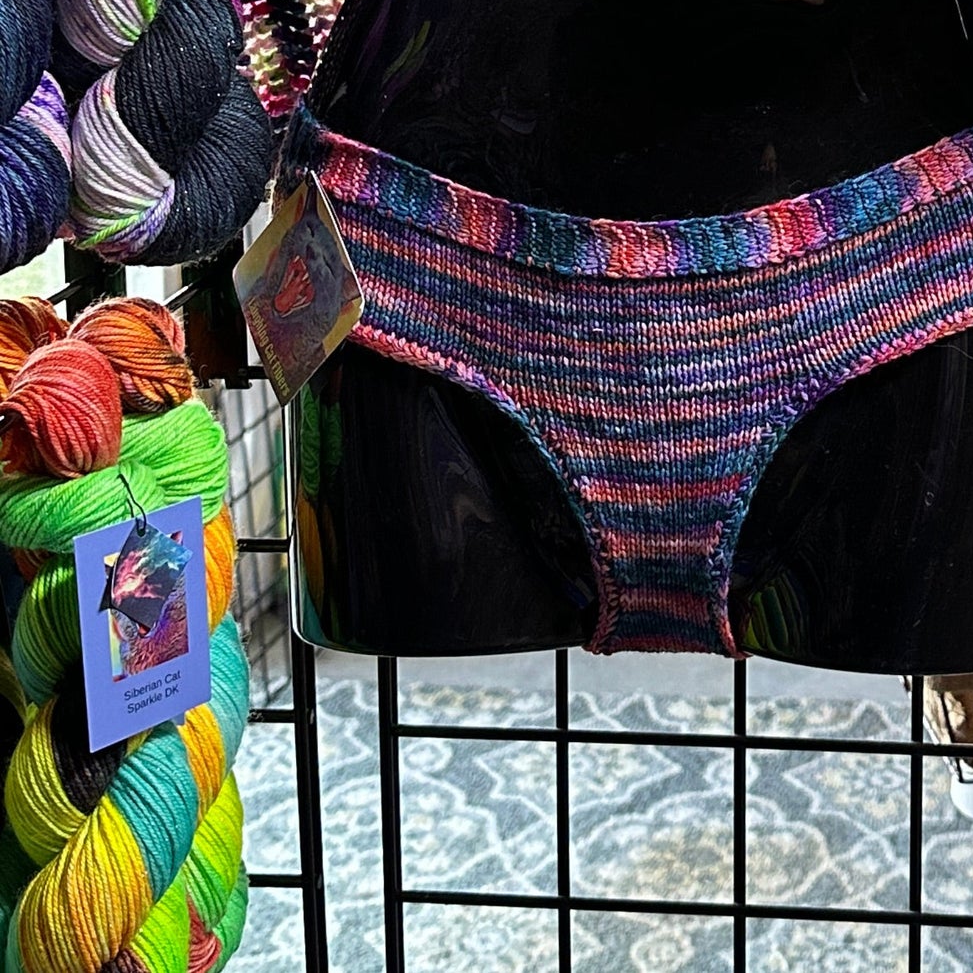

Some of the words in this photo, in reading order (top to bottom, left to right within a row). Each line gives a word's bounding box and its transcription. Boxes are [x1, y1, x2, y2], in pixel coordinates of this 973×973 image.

[248, 297, 270, 347] Laughing
[264, 343, 277, 364] Cat
[124, 679, 162, 701] Siberian
[164, 669, 181, 685] Cat
[127, 691, 163, 714] Sparkle
[165, 685, 179, 698] DK
